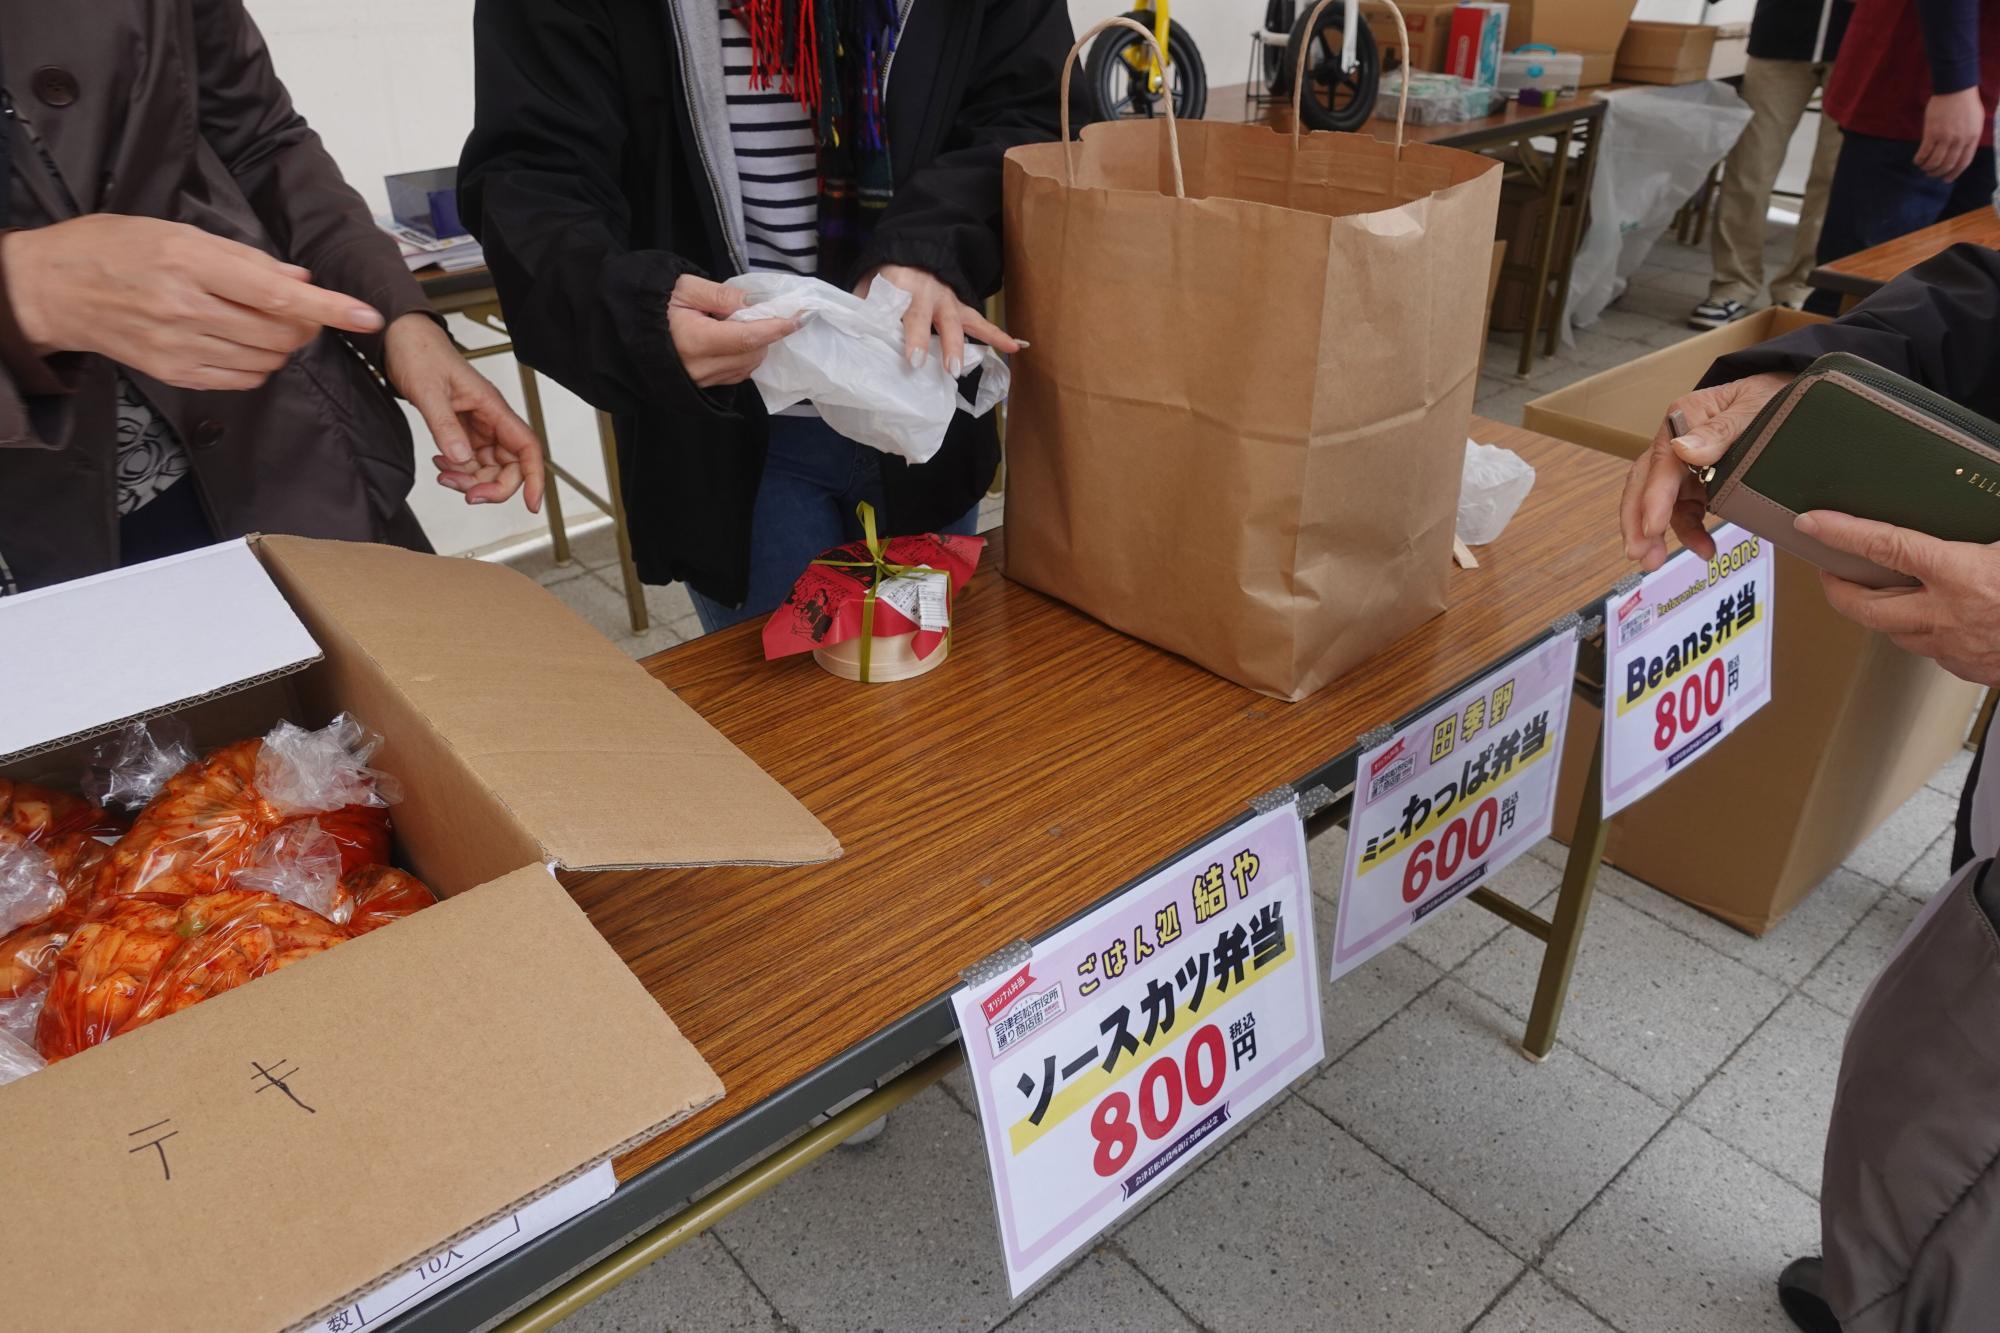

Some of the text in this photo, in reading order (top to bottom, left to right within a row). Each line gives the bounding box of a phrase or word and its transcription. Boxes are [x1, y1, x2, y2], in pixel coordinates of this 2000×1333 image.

[1707, 534, 1760, 588] Beans
[1626, 580, 1756, 705] Beans弁当
[1430, 678, 1515, 765] 田季野
[1653, 657, 1725, 751] 800
[1727, 668, 1739, 697] 円
[1402, 796, 1498, 903] 600
[1498, 804, 1516, 836] 円
[1077, 848, 1260, 995] ごはん処 結や
[987, 976, 1025, 1012] オリジナル弁当
[994, 987, 1059, 1037] 会津若松市役所
[997, 1009, 1043, 1049] 通り商店街
[1016, 901, 1288, 1127] ソースカツ弁当
[1229, 1015, 1256, 1041] 税込
[1090, 1023, 1227, 1177] 800
[1231, 1035, 1257, 1072] 円
